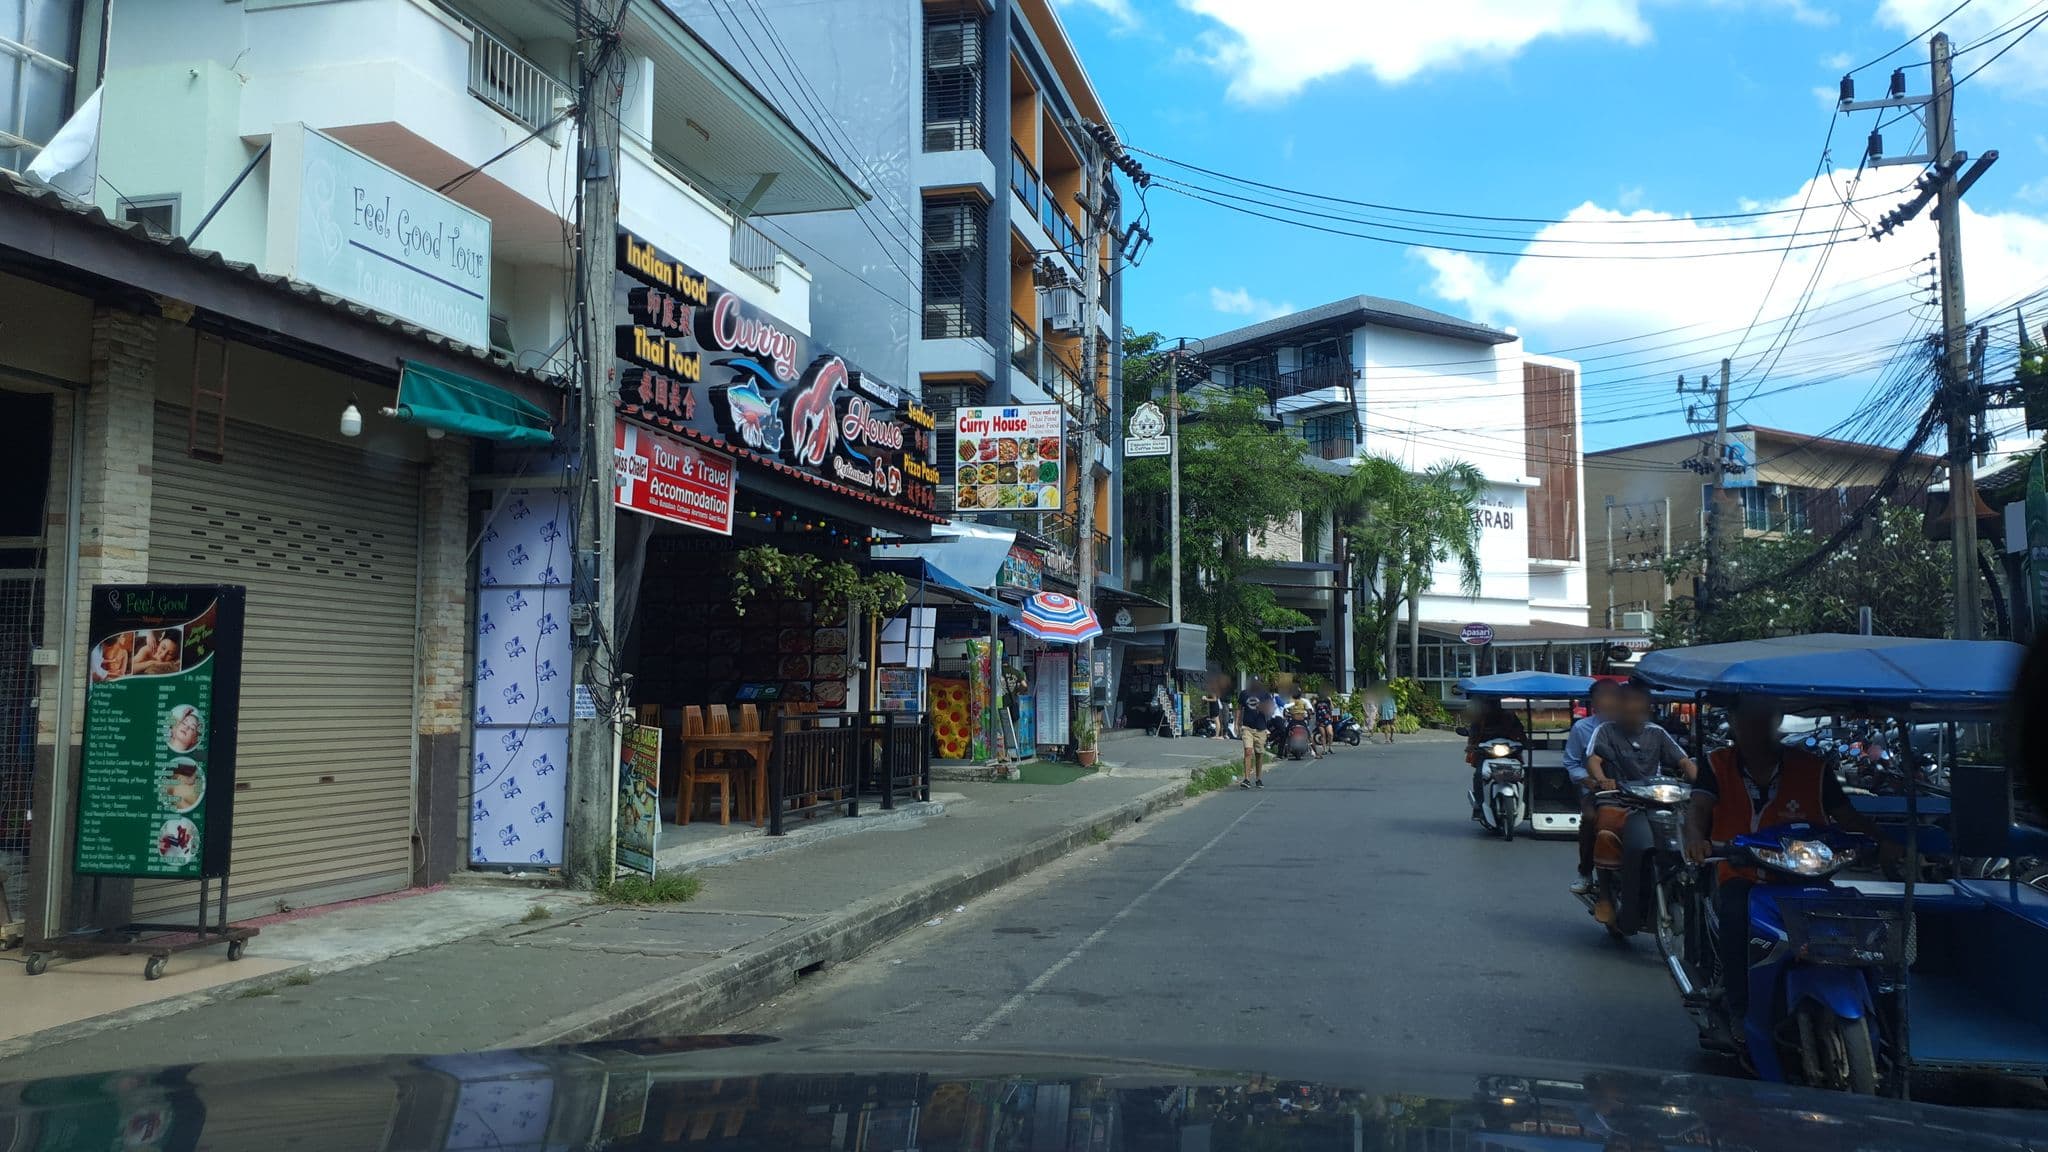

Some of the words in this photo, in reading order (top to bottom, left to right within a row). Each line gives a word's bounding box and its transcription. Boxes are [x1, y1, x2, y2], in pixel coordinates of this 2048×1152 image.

[353, 186, 391, 240] Feel
[397, 208, 443, 262] Good
[447, 226, 484, 279] Tour
[356, 257, 402, 307] Tourist
[627, 234, 673, 287] Indian
[676, 263, 708, 305] Food
[634, 326, 666, 368] Thai
[669, 340, 701, 382] Food
[712, 291, 801, 382] Curry
[842, 396, 904, 450] House
[908, 400, 936, 430] Seafood
[959, 416, 989, 437] Curry
[993, 416, 1028, 433] House
[628, 455, 648, 478] Chalet
[653, 444, 680, 471] Tour
[682, 455, 694, 477] &
[697, 459, 729, 489] Travel
[833, 455, 874, 487] Restaurant
[903, 452, 922, 479] Pizza
[922, 461, 941, 484] Pasta
[650, 476, 727, 515] Accommodation
[1476, 509, 1514, 530] KRABI
[126, 591, 153, 615] Feel
[158, 592, 188, 615] Good
[1462, 629, 1490, 637] Apasari
